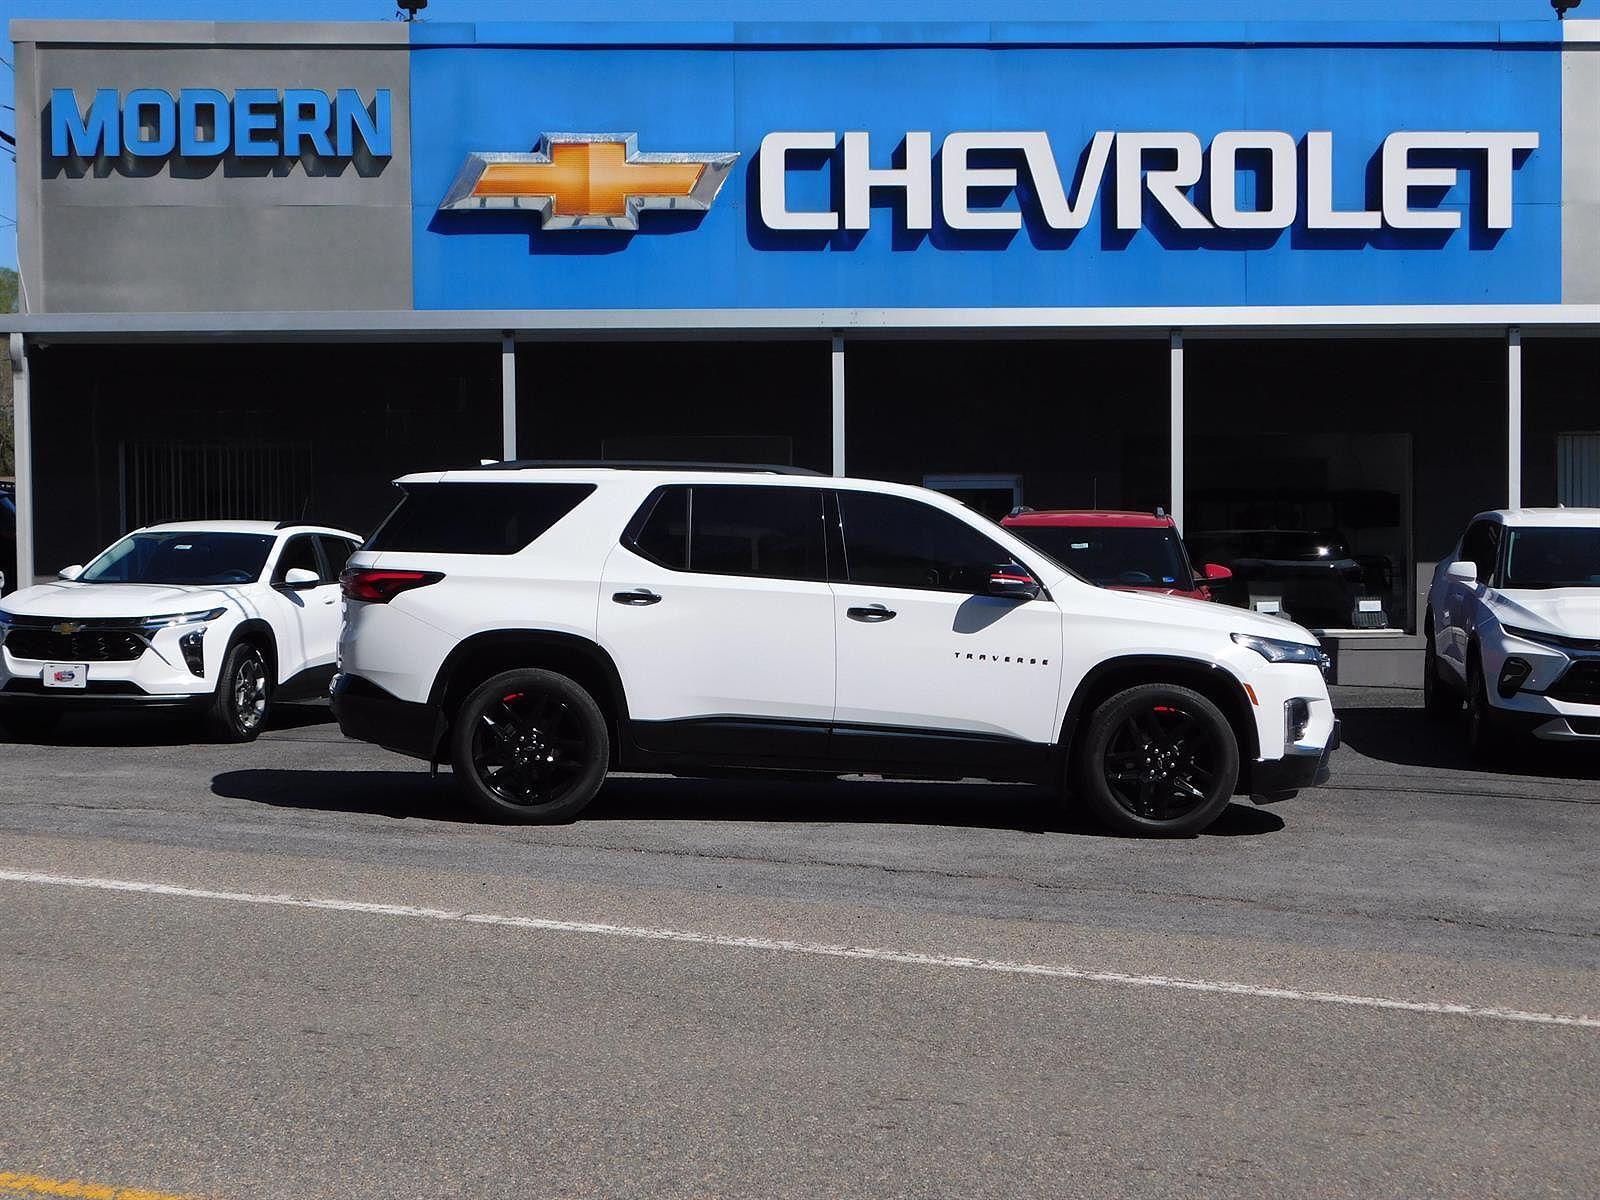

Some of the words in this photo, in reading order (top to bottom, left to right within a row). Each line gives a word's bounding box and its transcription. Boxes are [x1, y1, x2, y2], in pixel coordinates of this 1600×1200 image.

[51, 88, 392, 157] MODERN
[759, 131, 1539, 230] CHEVROLET
[954, 651, 1049, 666] TRAVERSE
